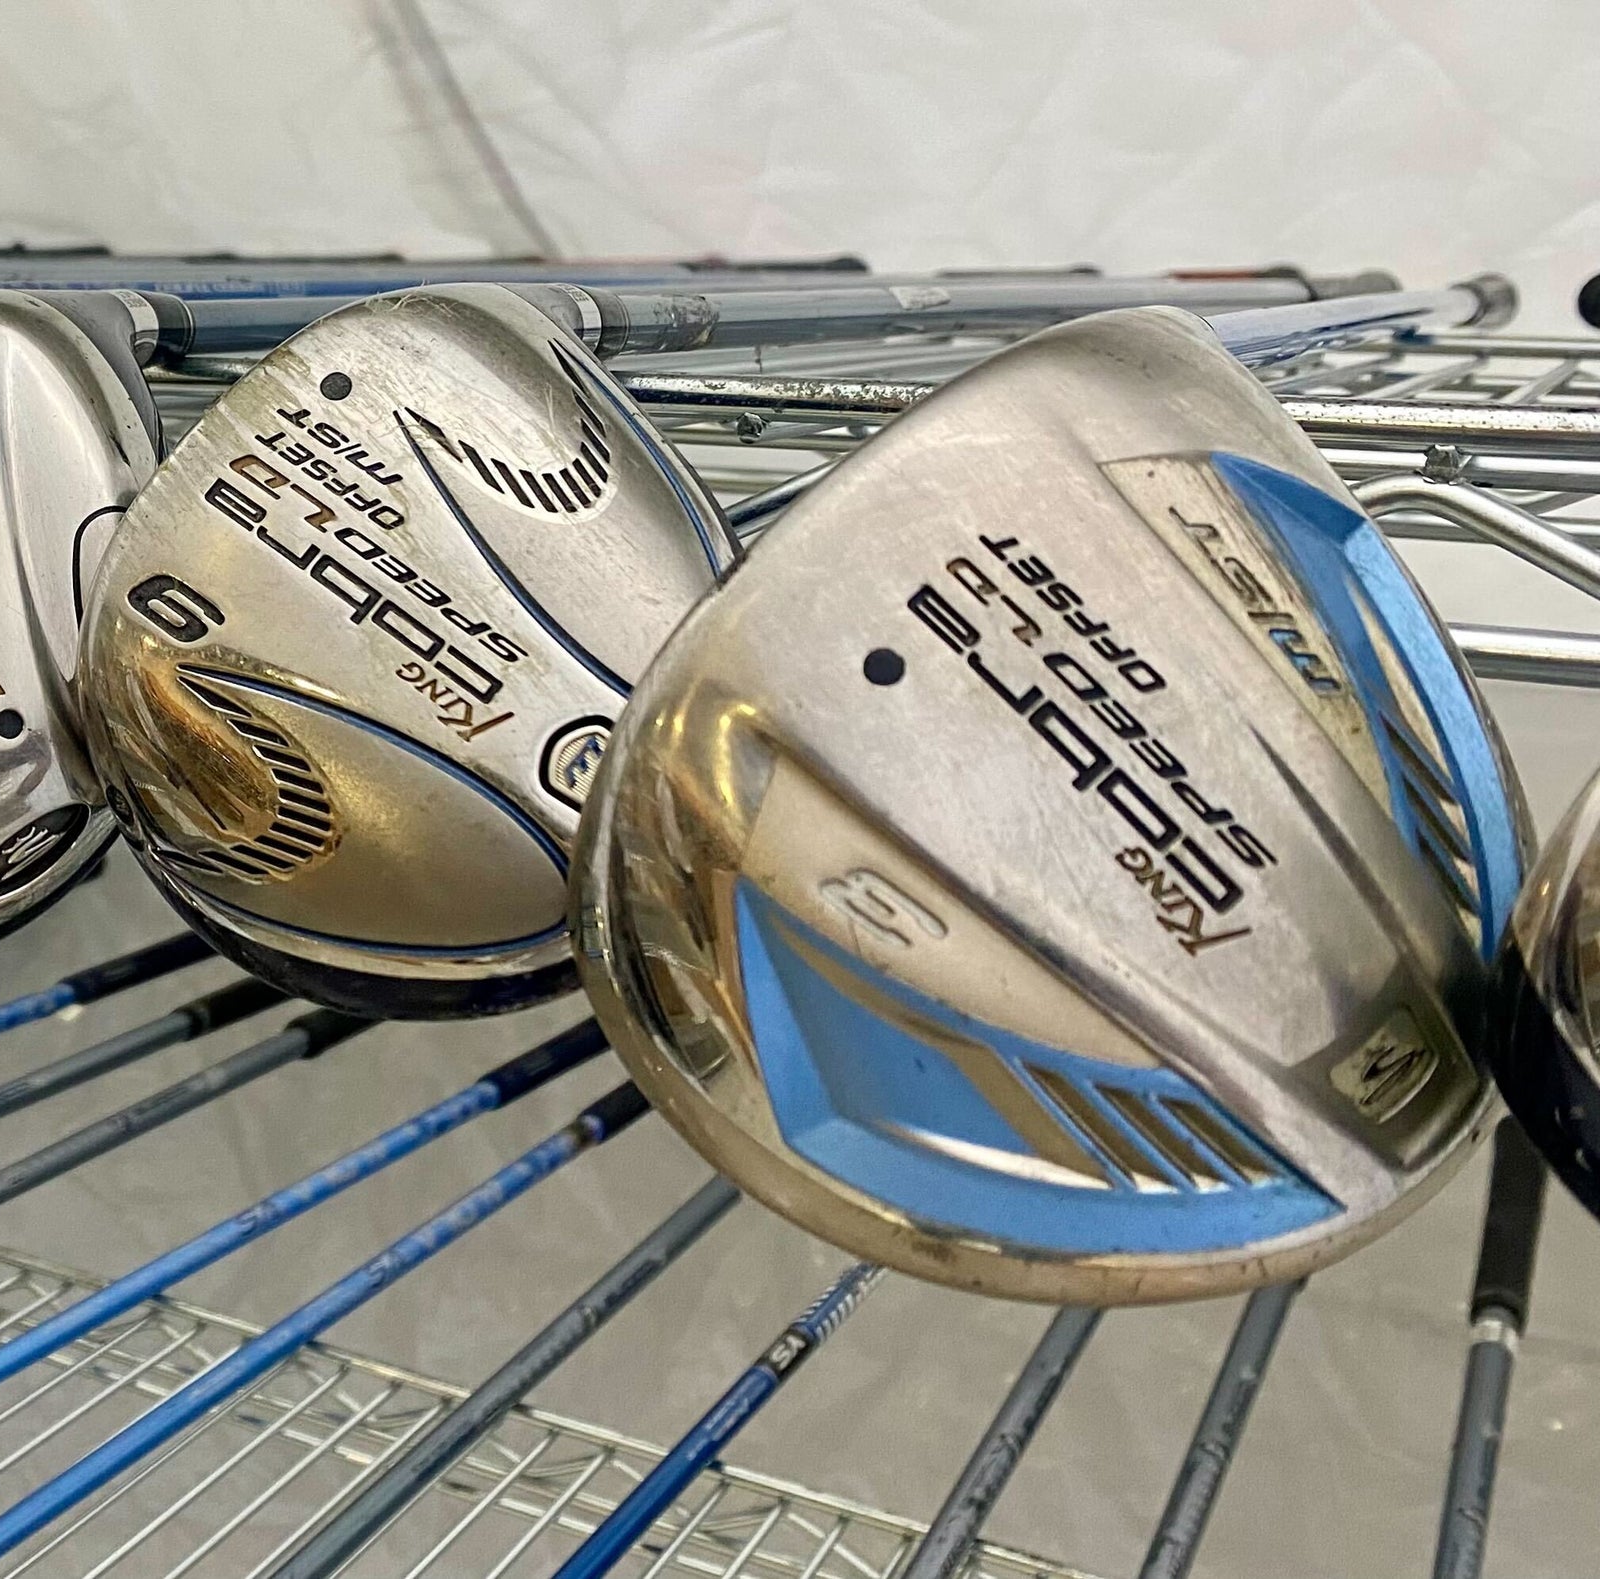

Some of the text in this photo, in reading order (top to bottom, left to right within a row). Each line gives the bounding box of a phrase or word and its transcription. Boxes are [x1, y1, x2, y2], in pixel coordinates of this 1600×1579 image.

[254, 432, 405, 530] OFFSET
[204, 477, 504, 705] cobra
[334, 527, 530, 663] SPEED
[978, 534, 1167, 693] OFFSET
[395, 661, 515, 743] KING
[907, 583, 1245, 915] cobra
[1043, 653, 1279, 869] SPEED
[817, 866, 949, 947] 3
[1115, 846, 1253, 957] KING
